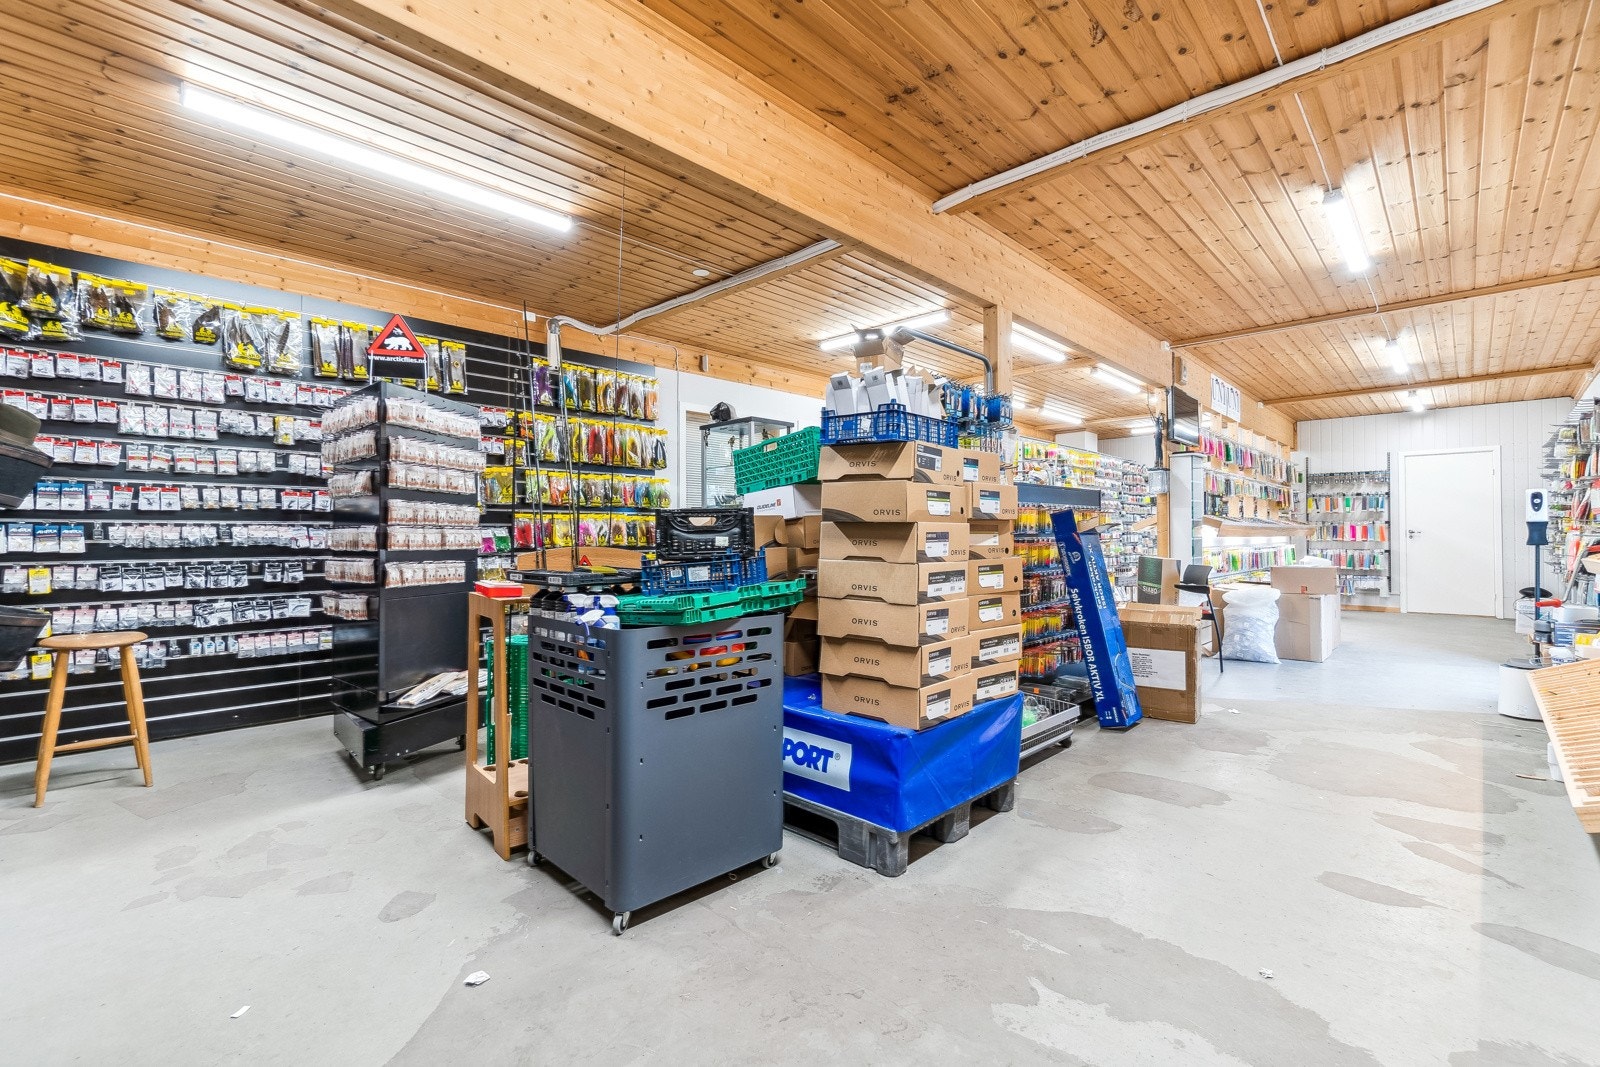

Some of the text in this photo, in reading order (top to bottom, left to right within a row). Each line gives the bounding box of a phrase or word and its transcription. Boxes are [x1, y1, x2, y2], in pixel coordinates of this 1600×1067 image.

[367, 355, 427, 363] www.arcticflies.no
[849, 460, 877, 468] ORVIS
[943, 474, 957, 482] ORVIS
[982, 475, 997, 483] ORVIS
[873, 508, 901, 516] ORVIS
[1001, 507, 1016, 515] ORVIS
[852, 539, 878, 547] ORVIS
[852, 584, 878, 592] ORVIS
[852, 617, 878, 627] ORVIS
[950, 625, 966, 634] ORVIS
[1070, 588, 1105, 702] Sølvkroken ISBOR AKTIV XL
[854, 656, 880, 666] ORVIS
[953, 662, 969, 672] ORVIS
[854, 695, 880, 706] ORVIS
[953, 700, 970, 711] ORVIS
[783, 737, 834, 773] PORT
